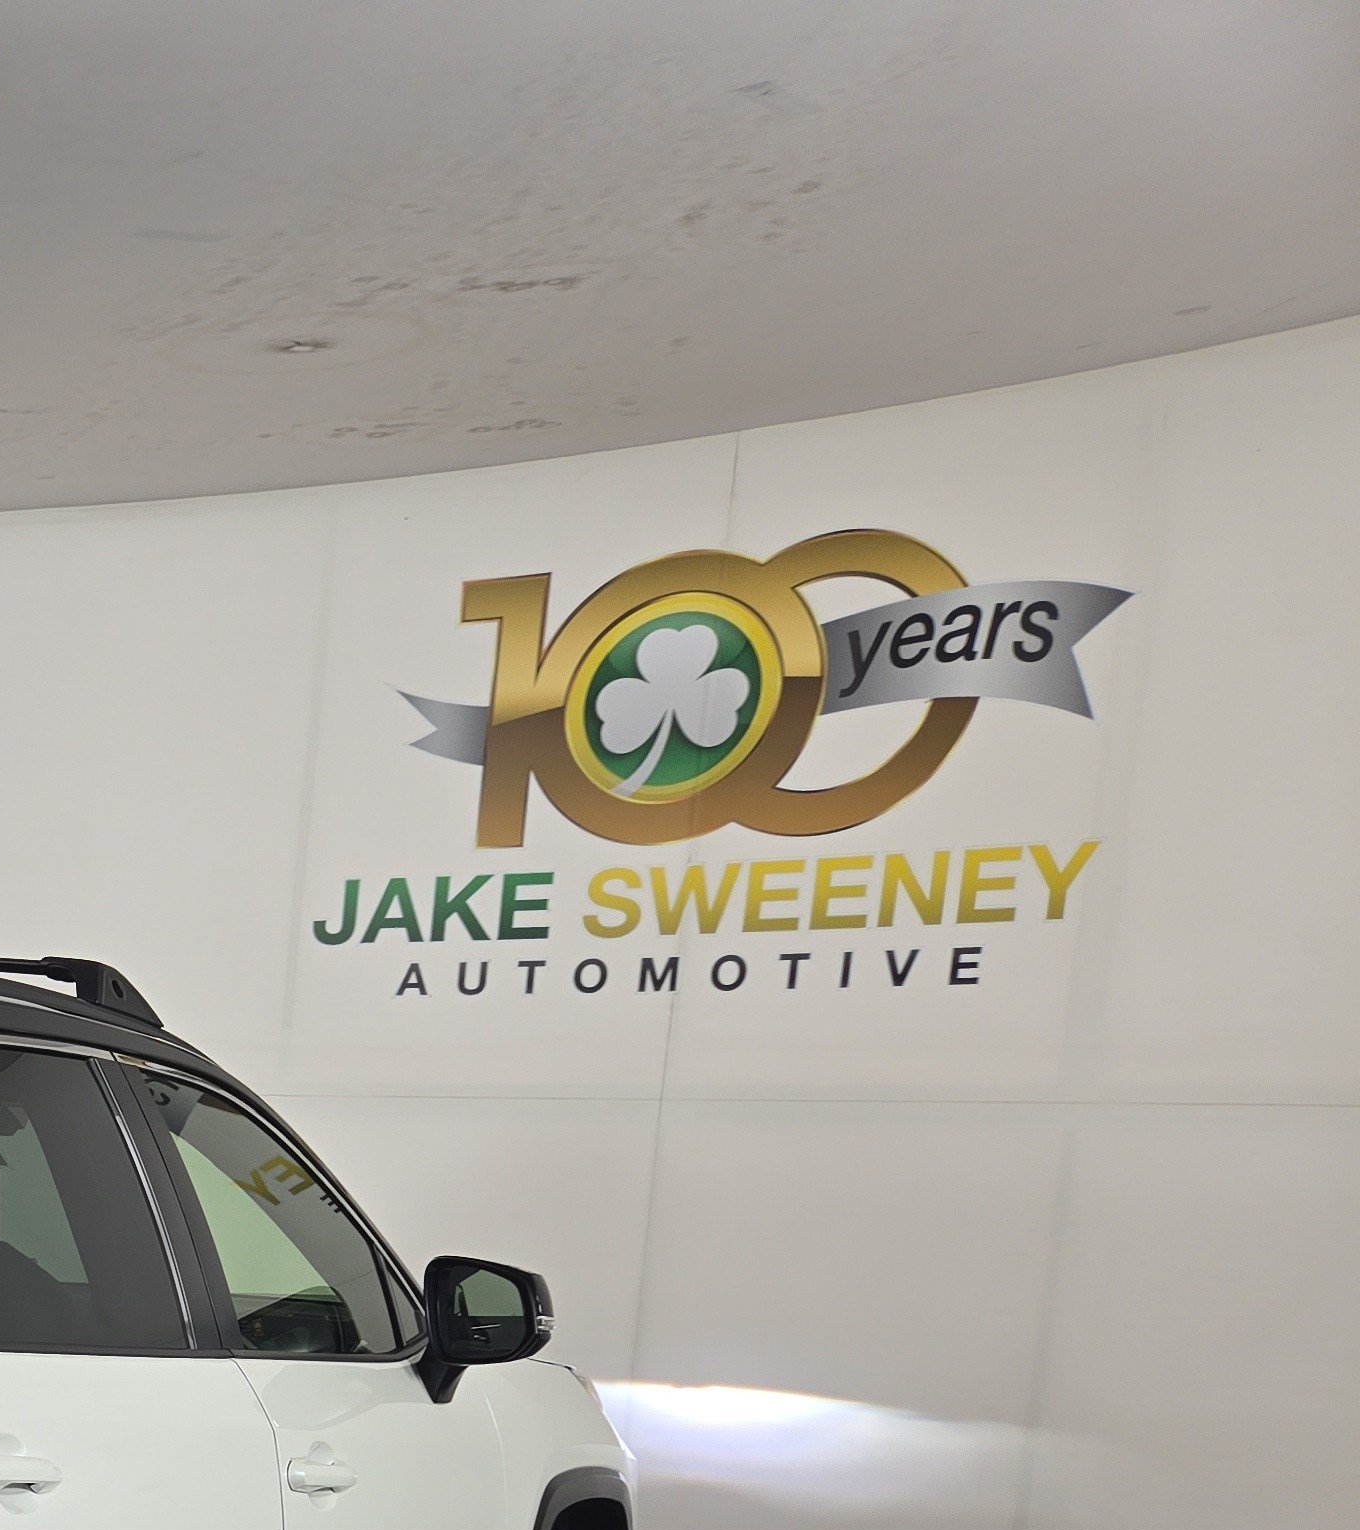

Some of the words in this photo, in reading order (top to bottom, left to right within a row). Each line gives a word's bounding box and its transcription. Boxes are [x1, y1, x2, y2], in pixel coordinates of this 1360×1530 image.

[460, 528, 982, 850] 100
[837, 598, 1060, 699] years
[313, 871, 554, 946] JAKE
[582, 841, 1102, 940] SWEENEY
[396, 946, 983, 997] AUTOMOTIVE
